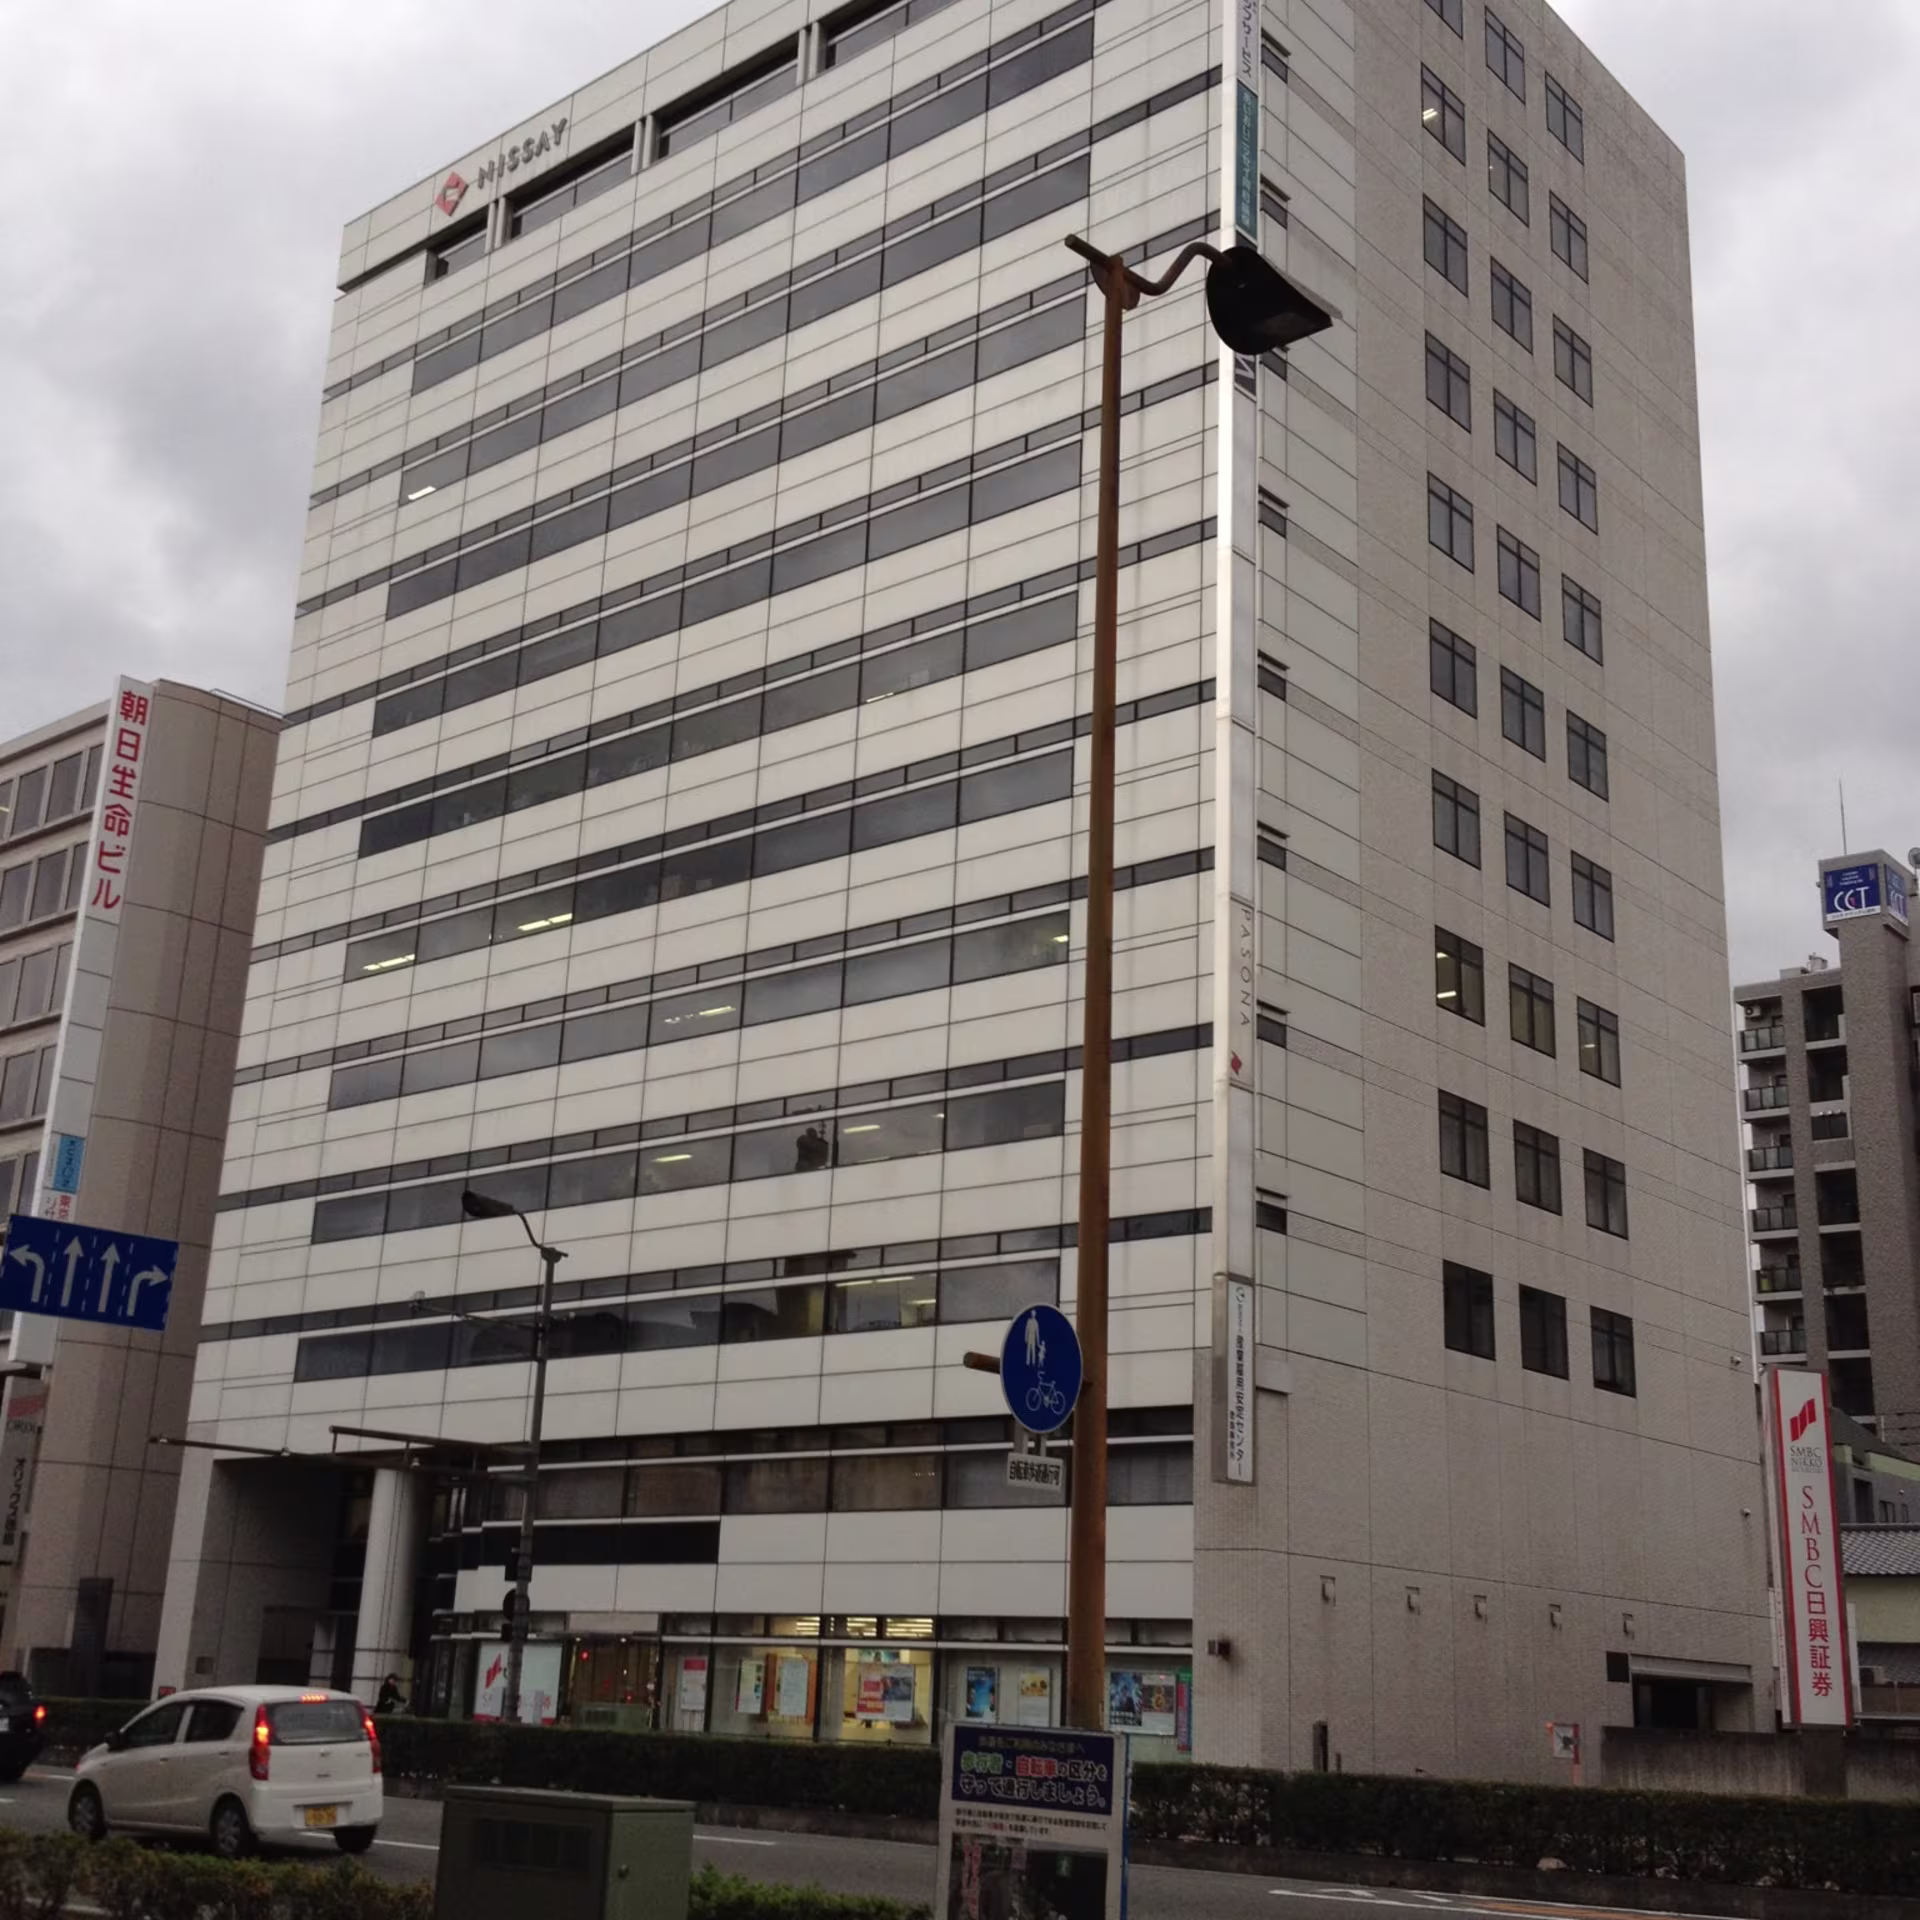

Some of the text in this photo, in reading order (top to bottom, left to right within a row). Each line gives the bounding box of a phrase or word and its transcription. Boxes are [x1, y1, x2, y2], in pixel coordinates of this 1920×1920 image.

[479, 118, 567, 189] NISSAY
[92, 690, 149, 911] 朝日生命ビル
[1834, 886, 1870, 912] CCT
[1240, 907, 1252, 1027] PASONA
[1790, 1446, 1824, 1458] SMBC
[1800, 1485, 1834, 1698] SMBC日興証券
